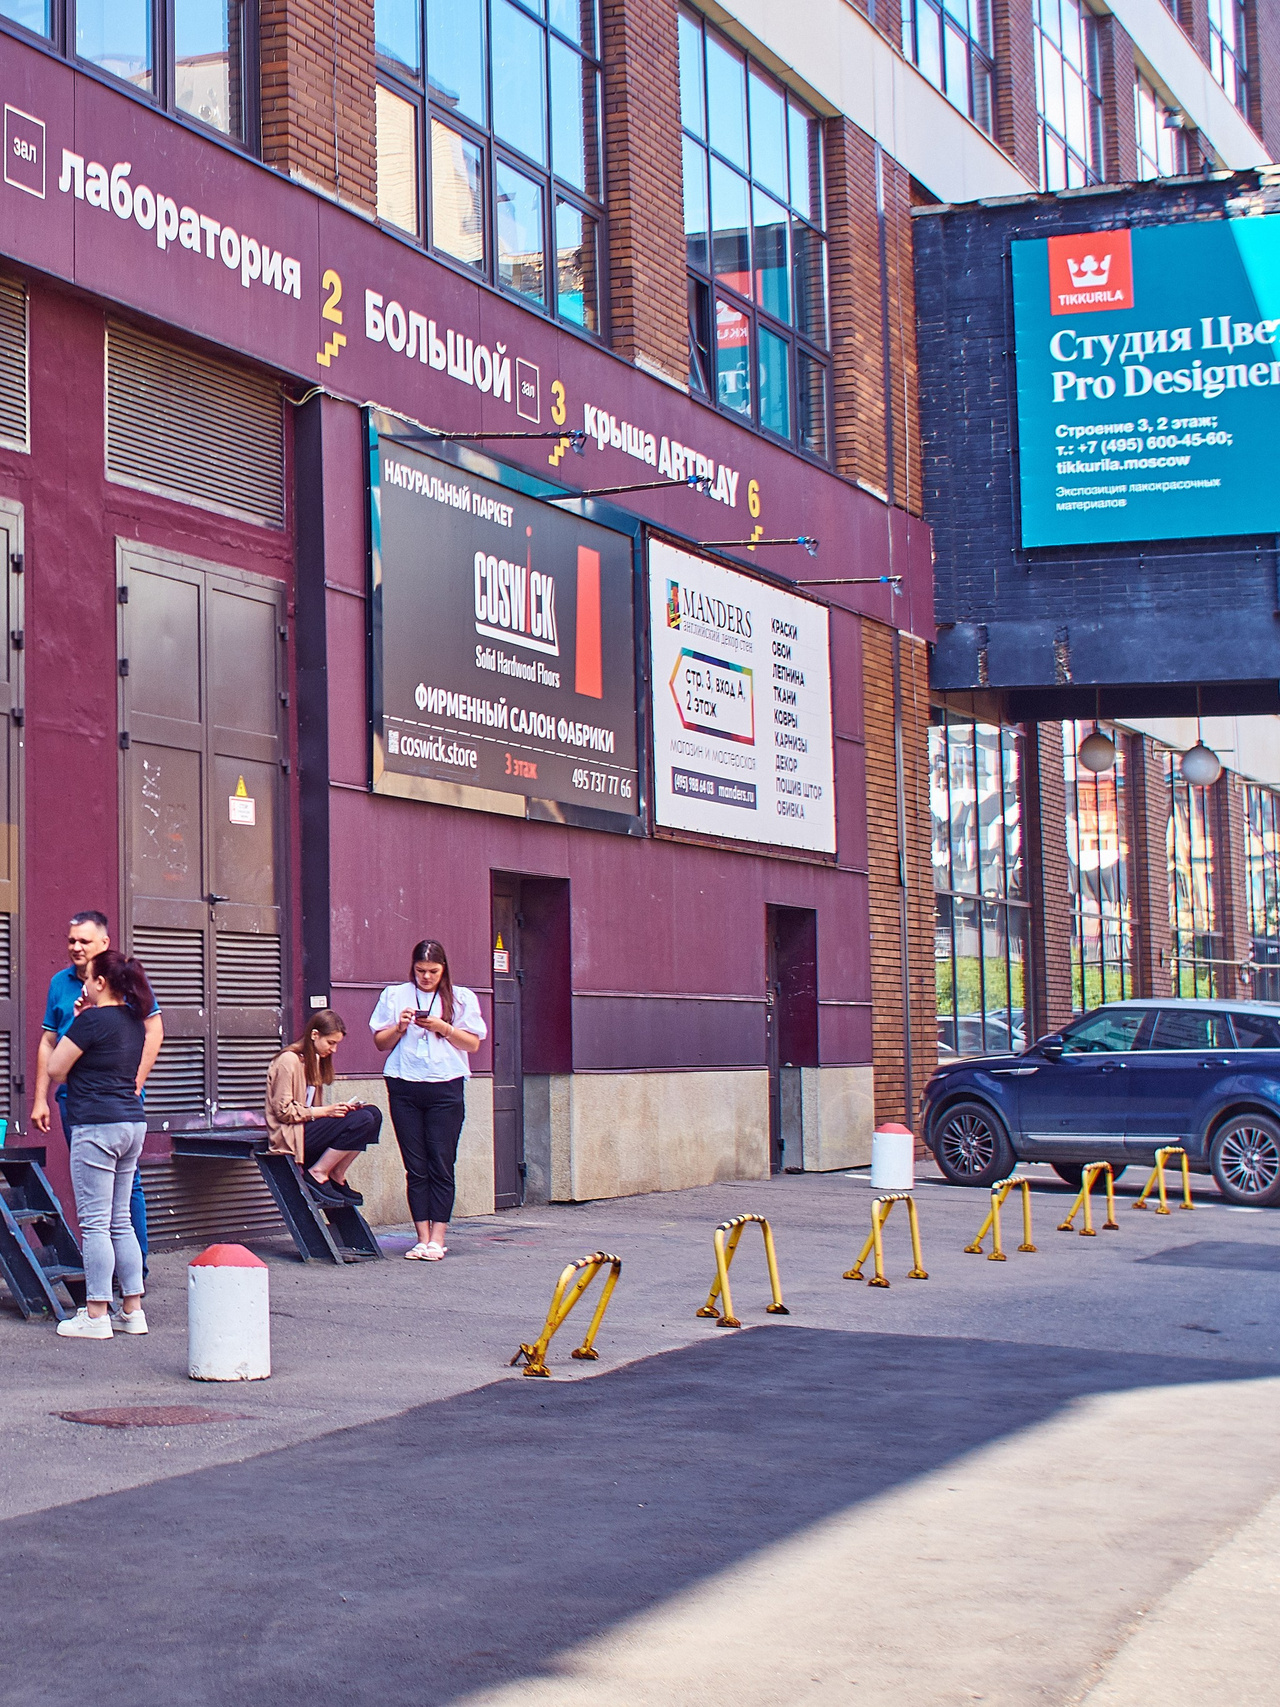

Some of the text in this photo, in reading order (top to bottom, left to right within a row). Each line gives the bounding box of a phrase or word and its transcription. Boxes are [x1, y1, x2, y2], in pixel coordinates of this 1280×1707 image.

[12, 134, 344, 325] зал лаборатория 2
[1058, 289, 1124, 306] TIKKURILA
[364, 287, 567, 426] БОЛЬШОЙ зал 3
[1049, 326, 1192, 367] Студия
[1051, 370, 1117, 403] Pro
[1055, 414, 1218, 441] Строение 3, 2 этаж;
[1077, 441, 1097, 454] +7
[1101, 438, 1144, 456] (495)
[1146, 431, 1234, 450] 600-45-60;
[583, 402, 761, 519] крыша ARTPLAY 6
[1056, 454, 1191, 475] tikkurila.moscow
[384, 458, 514, 528] НАТУРАЛЬНЫЙ ПАРКЕТ
[1055, 477, 1221, 499] Экспозиция лакокрасочных
[1056, 498, 1127, 512] материалов
[682, 588, 752, 639] MANDERS
[771, 617, 798, 641] КРАСКИ
[771, 641, 791, 661] ОБОИ
[475, 644, 560, 689] Solid Hardwood Floors
[772, 663, 805, 688] ЛЕПНИНА
[685, 667, 704, 694] стр.
[705, 670, 714, 693] 3,
[715, 676, 736, 700] вход
[773, 685, 797, 707] ТКАНИ
[415, 682, 615, 754] ФИРМЕННЫЙ САЛОН ФАБРИКИ
[686, 694, 717, 718] 2 этаж
[773, 708, 798, 729] КОВРЫ
[400, 733, 477, 770] coswick.store
[774, 731, 808, 754] КАРНИЗЫ
[505, 752, 538, 780] 3 этаж
[670, 738, 756, 773] магазин и мастерская
[775, 753, 798, 773] ДЕКОР
[572, 767, 632, 799] 495 737 77 66
[718, 784, 755, 803] manders.ru
[776, 776, 822, 799] ПОШИВ ШТОР
[777, 799, 805, 819] ОБИВКА
